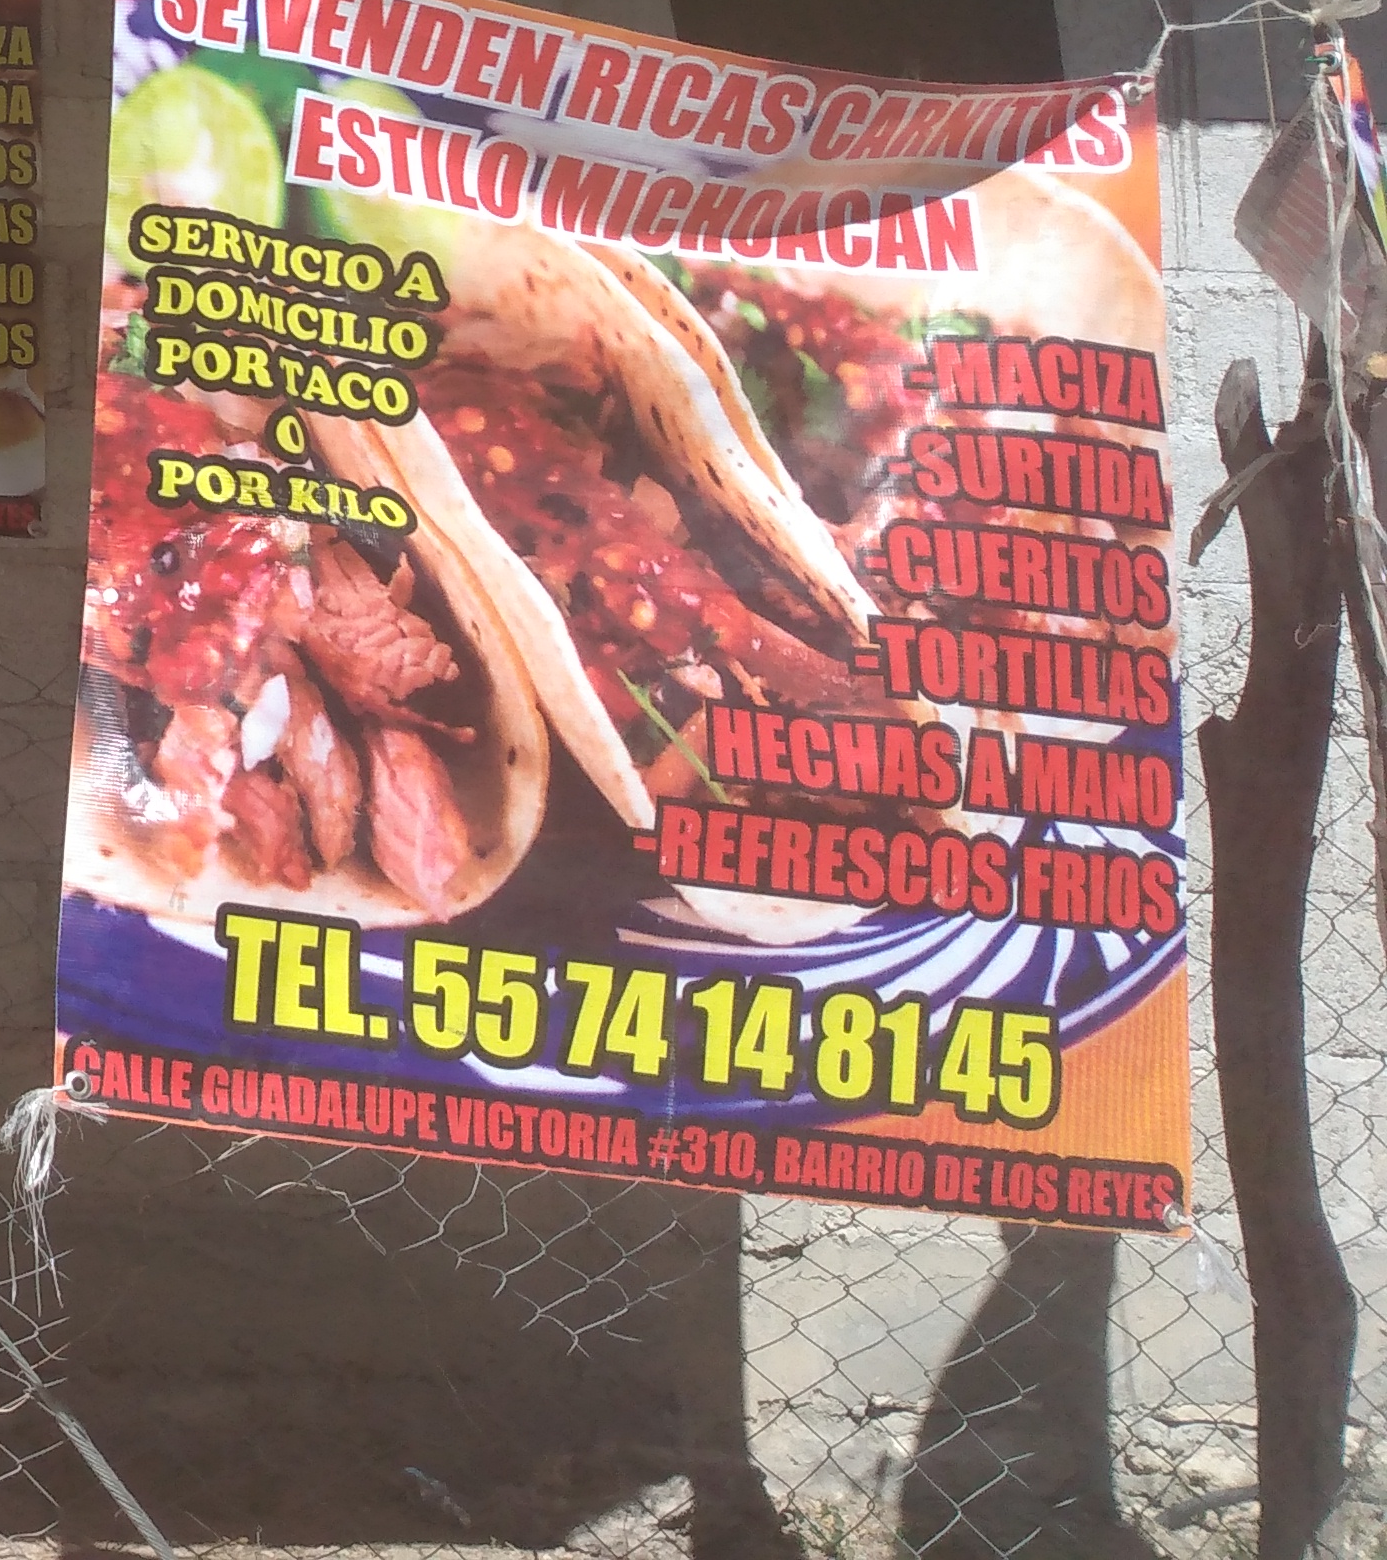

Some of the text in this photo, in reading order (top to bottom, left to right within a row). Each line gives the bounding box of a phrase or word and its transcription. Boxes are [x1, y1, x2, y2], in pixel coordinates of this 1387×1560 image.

[564, 41, 809, 156] RICAS
[808, 90, 1127, 169] CARNITAS
[293, 97, 979, 272] ESTILO MICHOACAN
[139, 214, 440, 303] SERVICIO A
[154, 275, 429, 360] DOMICILIO
[155, 337, 410, 417] POR TACO
[907, 340, 1162, 427] -MACIZA
[275, 415, 306, 455] O
[888, 431, 1165, 526] -SURTIDA
[157, 459, 408, 529] POR KILO
[862, 524, 1168, 625] -CUERITOS
[853, 622, 1171, 726] -TORTILLAS
[711, 706, 1174, 830] HECHAS A MANO
[633, 805, 1178, 934] -REFRESCOS FRIOS
[225, 913, 1054, 1120] TEL. 55 74 14 81 45
[72, 1044, 192, 1110] CALLE
[200, 1063, 438, 1143] GUADALUPE
[444, 1093, 639, 1169] VICTORIA
[774, 1137, 925, 1199] BARRIO
[934, 1155, 982, 1203] DE
[990, 1159, 1061, 1211] LOS
[1066, 1169, 1176, 1223] REYES
